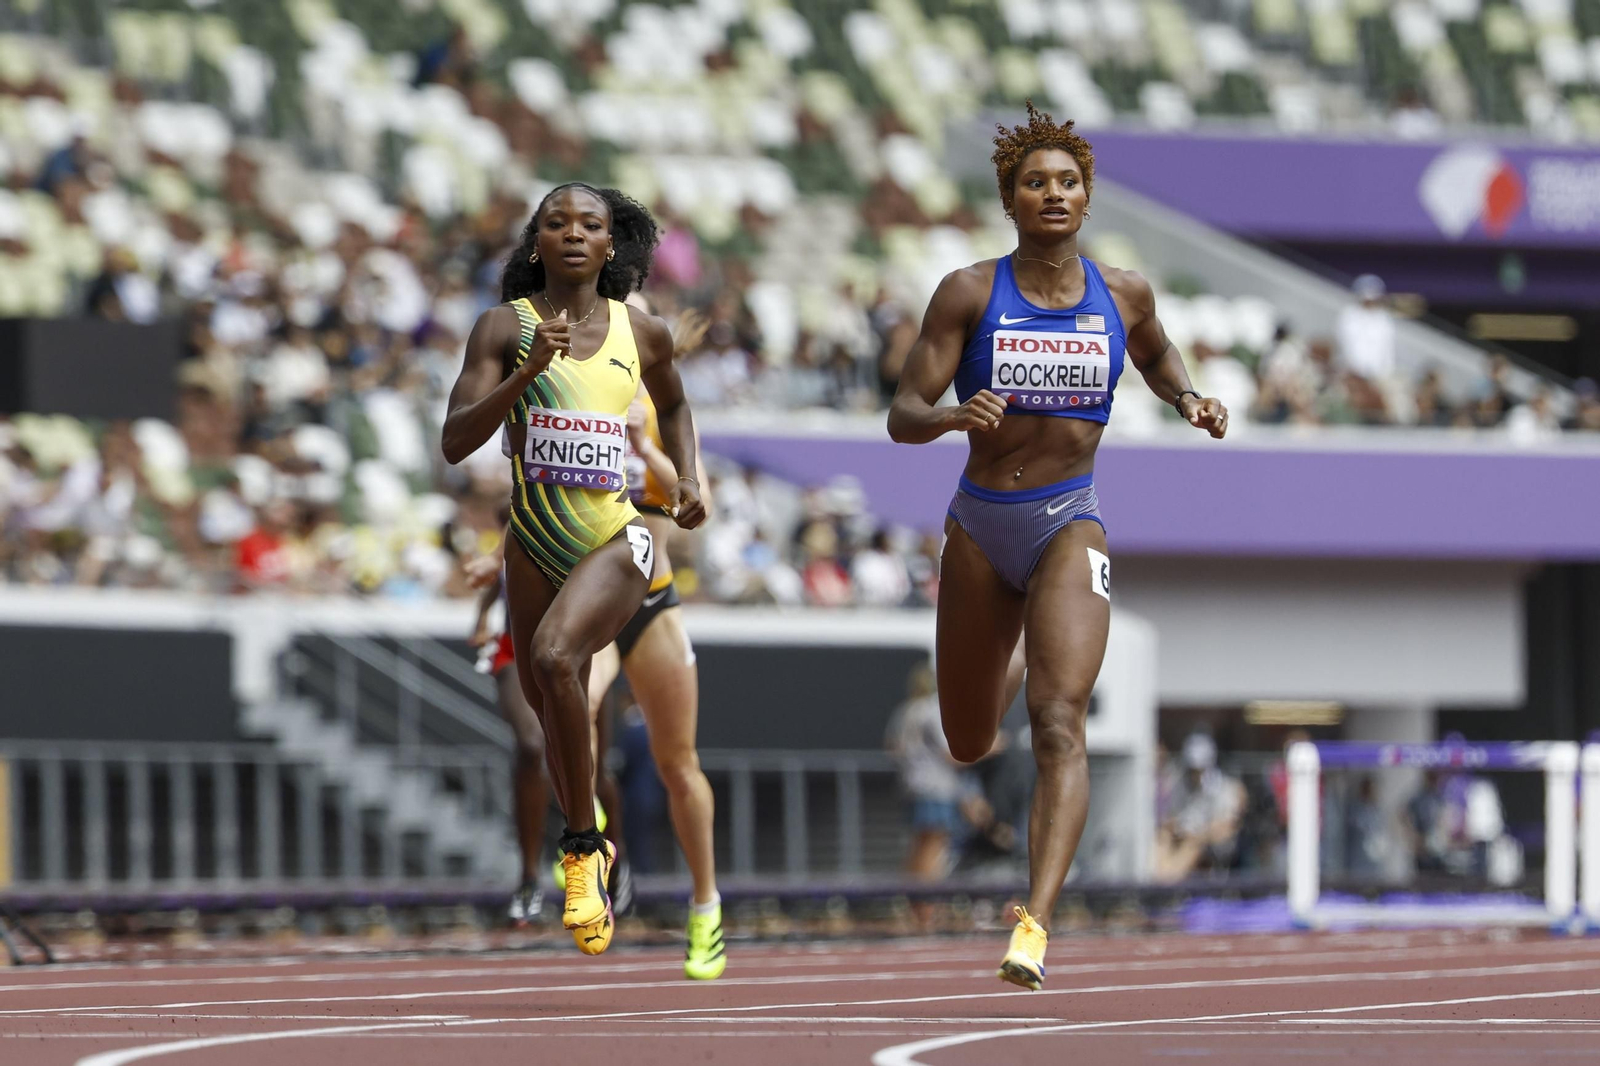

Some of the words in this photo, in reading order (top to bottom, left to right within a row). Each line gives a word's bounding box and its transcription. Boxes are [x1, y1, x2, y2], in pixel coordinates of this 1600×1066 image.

[996, 338, 1106, 355] HONDA
[998, 362, 1103, 388] COCKRELL
[530, 413, 623, 438] HONDA
[532, 438, 621, 469] KNIGHT
[640, 533, 651, 564] 7
[1101, 562, 1110, 594] 6
